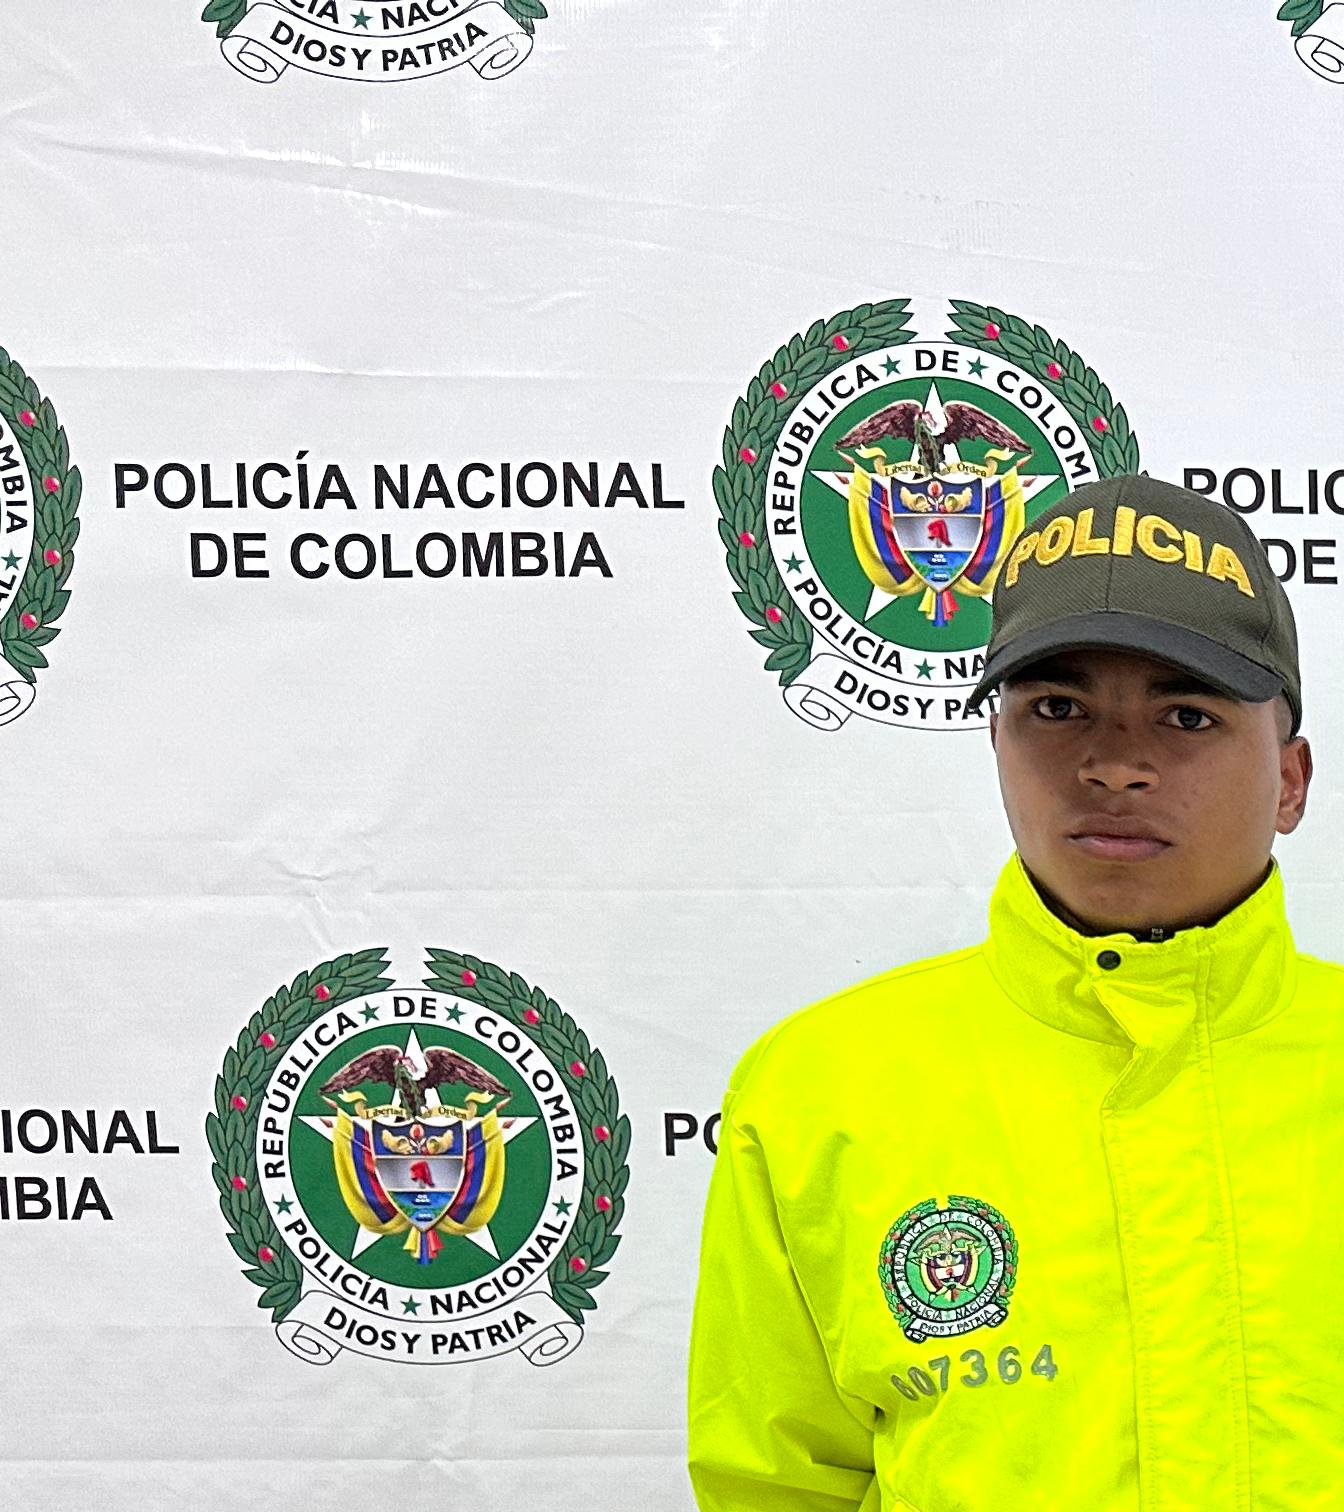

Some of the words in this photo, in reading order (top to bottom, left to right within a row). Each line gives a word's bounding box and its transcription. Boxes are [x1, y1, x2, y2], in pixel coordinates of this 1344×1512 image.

[383, 21, 489, 71] PATRIA
[773, 362, 880, 537] REPÚBLICA
[915, 349, 960, 373] DE
[114, 450, 347, 510] POLICÍA
[374, 461, 685, 510] NACIONAL
[190, 532, 270, 579] DE
[290, 531, 614, 580] COLOMBIA
[1004, 505, 1255, 598] POLICIA
[1259, 538, 1338, 585] DE
[794, 578, 904, 676] POLICÍA
[264, 1011, 359, 1180] REPÚBLICA
[393, 996, 437, 1020] DE
[474, 1016, 579, 1182] COLOMBIA
[0, 1108, 180, 1154] IONAL
[285, 1218, 390, 1311] POLICÍA
[429, 1217, 568, 1316] NACIONAL
[431, 1310, 537, 1356] PATRIA
